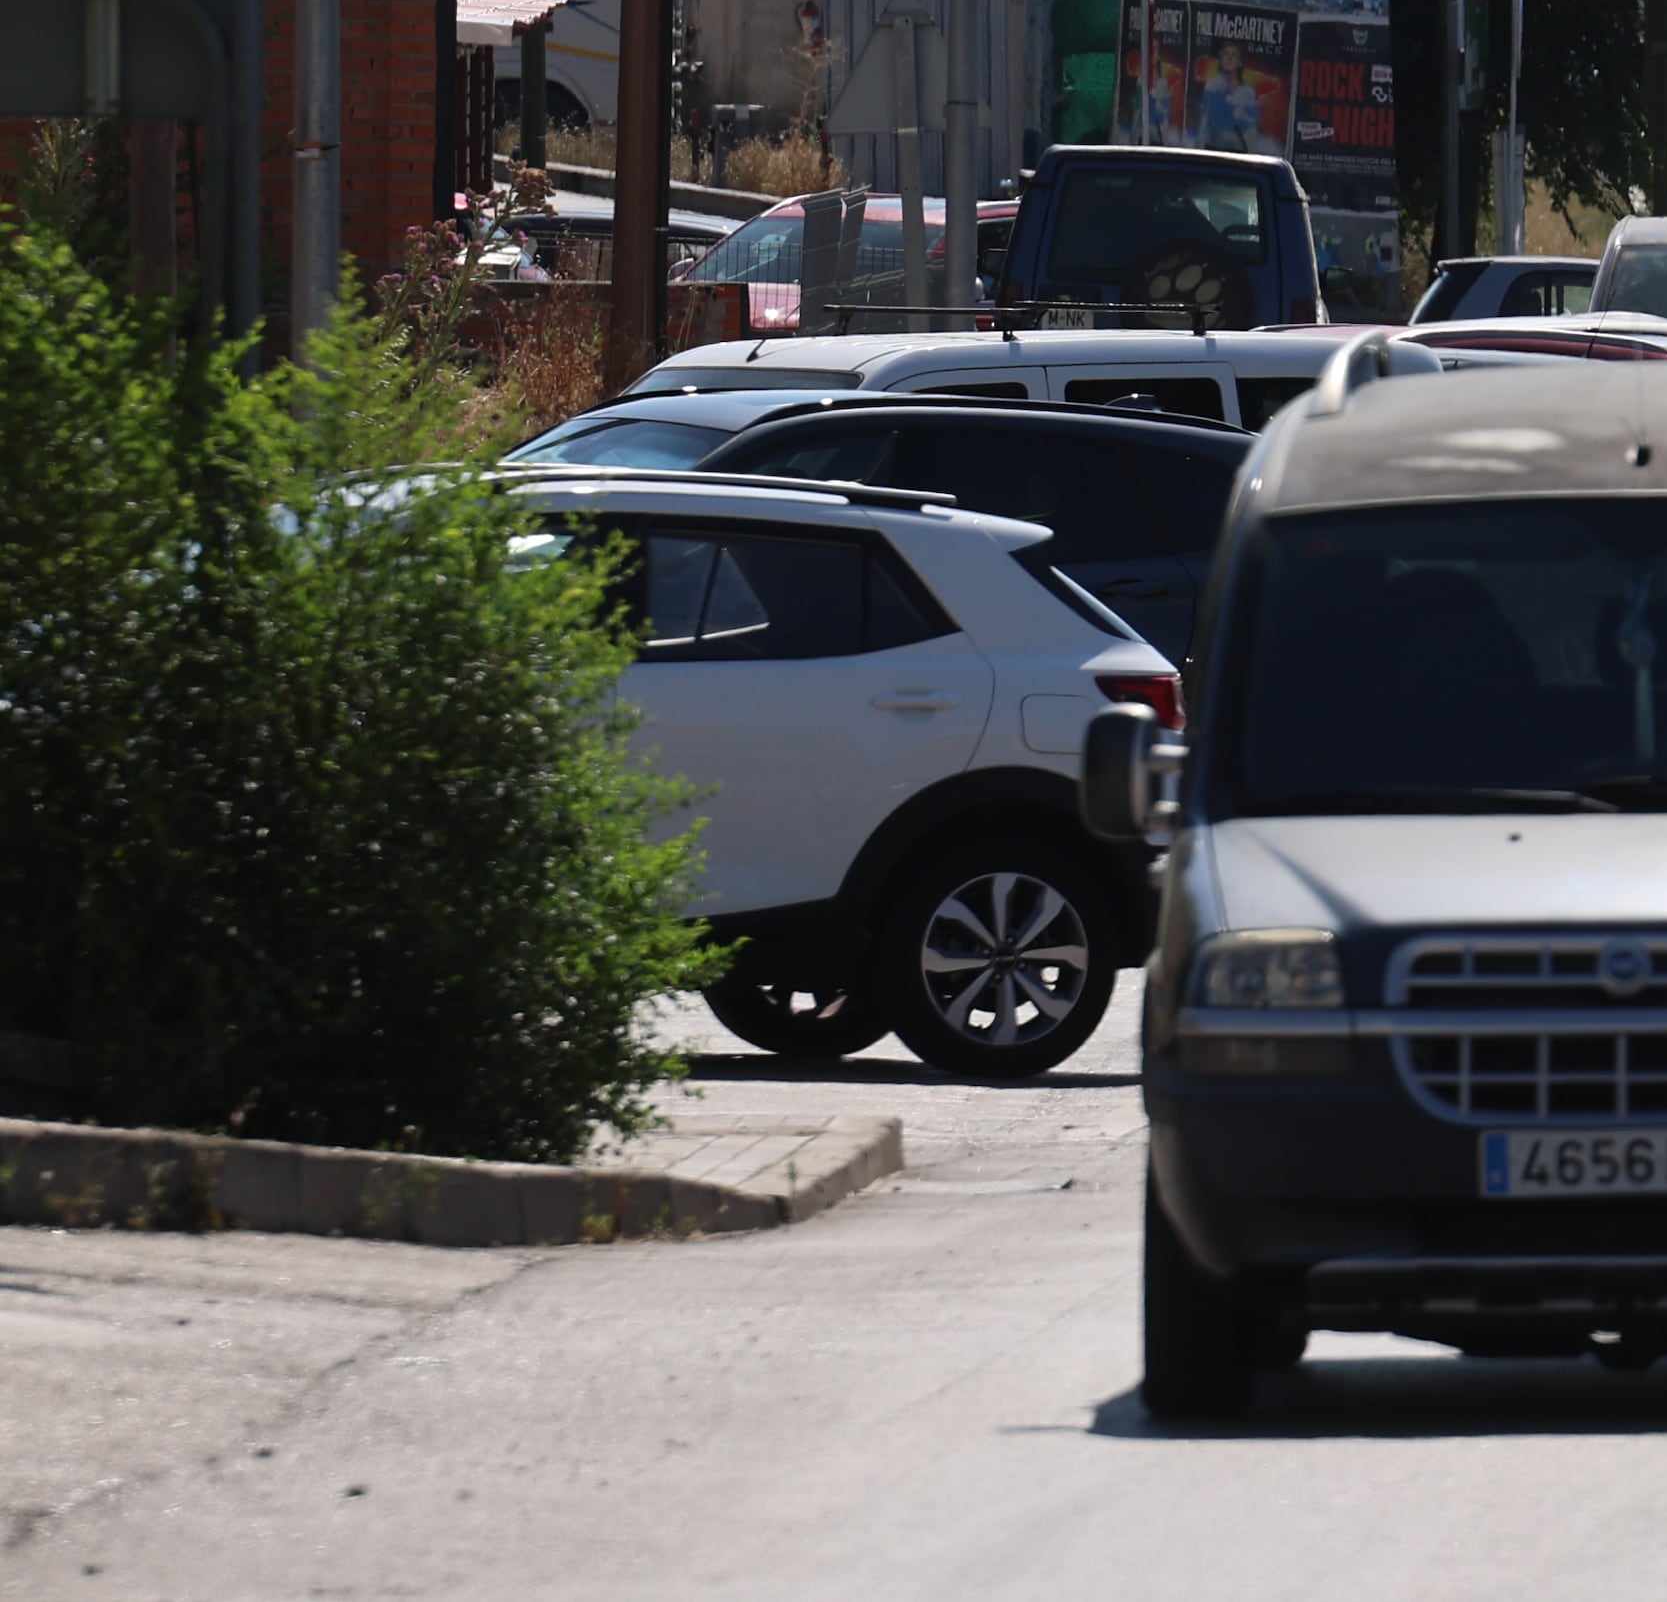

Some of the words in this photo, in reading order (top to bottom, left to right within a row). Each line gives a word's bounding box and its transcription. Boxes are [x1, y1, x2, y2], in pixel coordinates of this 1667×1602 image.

[1196, 11, 1213, 36] PAUL
[1214, 12, 1286, 45] McCARTNEY
[1300, 59, 1366, 103] ROCK
[1521, 1136, 1655, 1187] 4656
